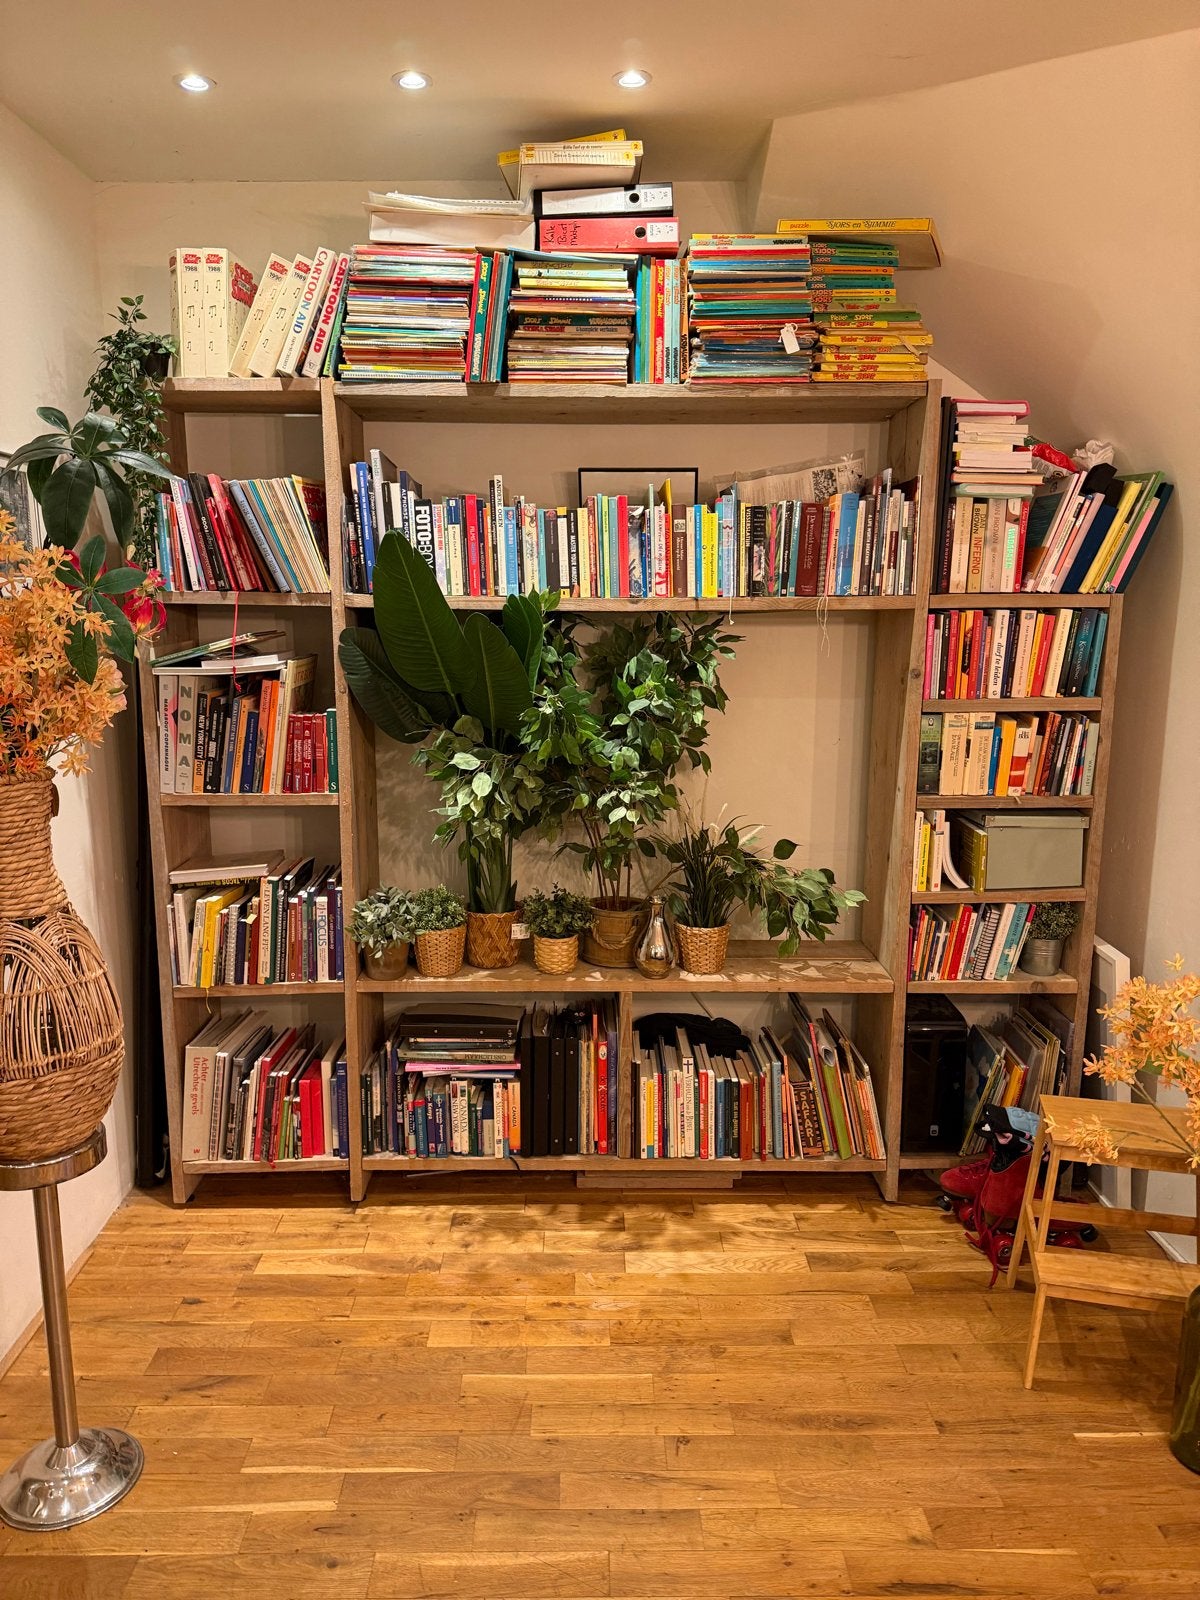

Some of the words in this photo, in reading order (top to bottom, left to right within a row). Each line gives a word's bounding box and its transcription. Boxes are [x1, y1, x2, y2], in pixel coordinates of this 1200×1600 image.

[789, 222, 810, 230] puzzle
[269, 272, 282, 282] 1990
[302, 250, 328, 310] CARTOON
[321, 257, 349, 326] CARTOON
[292, 311, 307, 335] AID
[313, 328, 327, 354] AID
[809, 515, 816, 524] De
[972, 507, 981, 535] BROWN
[979, 513, 987, 529] DAN
[992, 516, 1001, 544] BROWN
[808, 525, 816, 544] wereld
[807, 544, 815, 555] van
[864, 542, 872, 566] BREATHING
[971, 536, 983, 575] INFERNO
[806, 555, 815, 569] Sofie
[994, 642, 1004, 658] durf
[992, 666, 1002, 686] leiden
[178, 685, 192, 768] NOMA
[198, 714, 206, 729] NEW
[197, 729, 205, 745] YORK
[196, 745, 204, 759] CITY
[196, 760, 204, 776] Food
[262, 915, 270, 938] LANG
[317, 914, 327, 947] FOCUS
[261, 938, 269, 952] FIT
[192, 1056, 201, 1092] Utrechtse
[201, 1056, 209, 1082] Achter
[684, 1074, 693, 1105] VERHALEN
[191, 1093, 200, 1116] gevels
[800, 1091, 815, 1147] SAFARI
